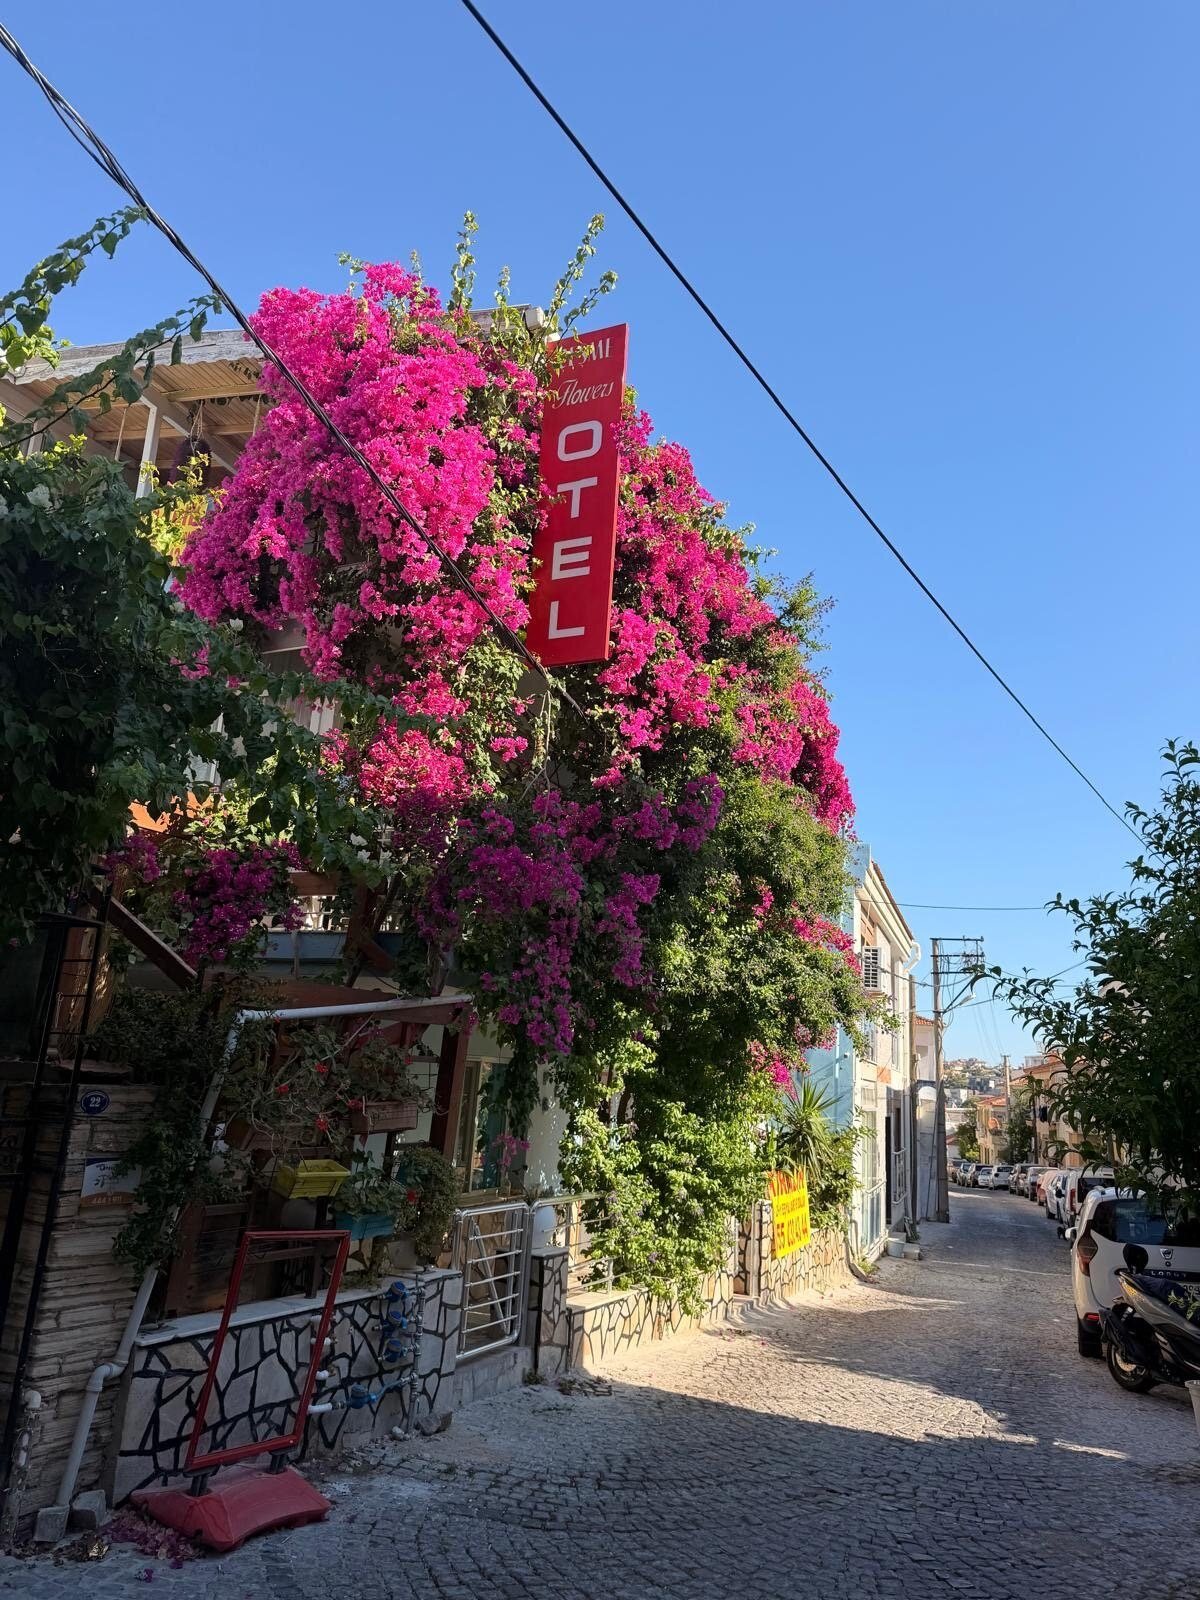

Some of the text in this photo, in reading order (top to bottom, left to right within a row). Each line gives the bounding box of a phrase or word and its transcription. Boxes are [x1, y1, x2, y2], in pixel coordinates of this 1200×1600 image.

[552, 378, 615, 410] Flowers
[547, 419, 603, 641] OTEL
[89, 1096, 101, 1108] 22
